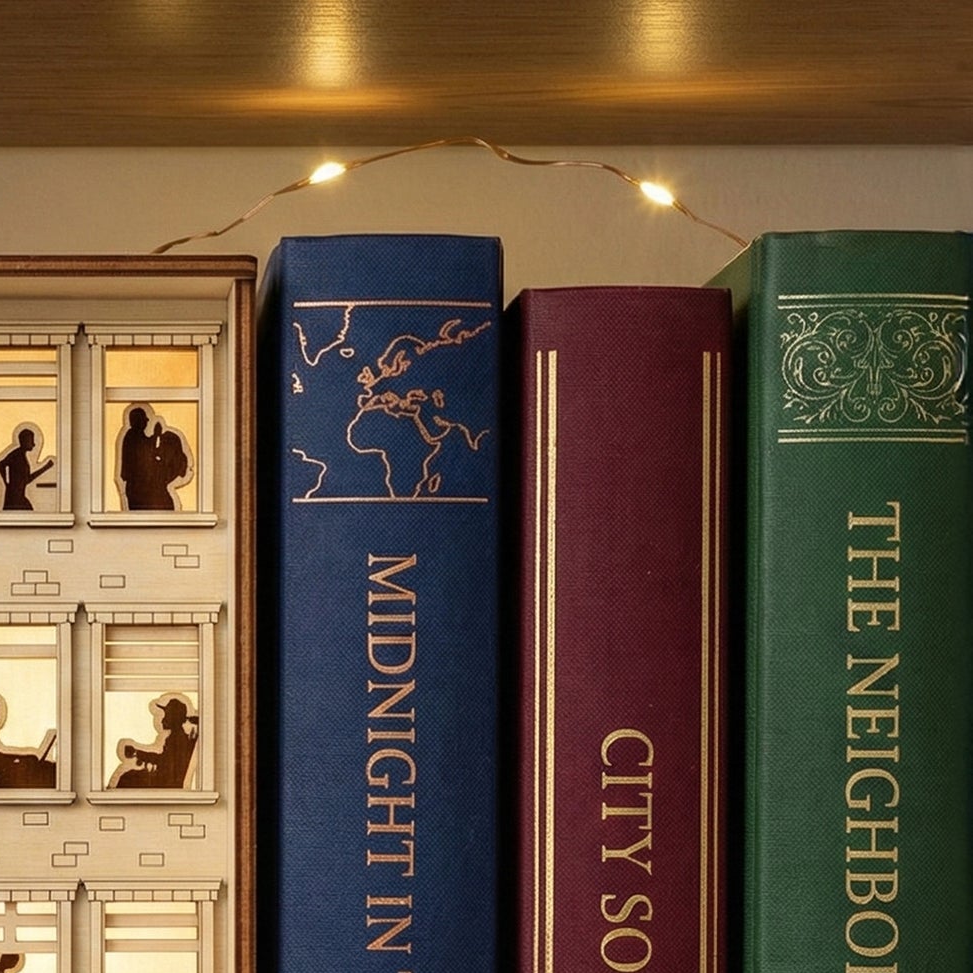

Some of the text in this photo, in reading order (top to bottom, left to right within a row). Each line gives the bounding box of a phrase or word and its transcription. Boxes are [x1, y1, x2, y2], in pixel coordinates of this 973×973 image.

[847, 501, 901, 633] THE
[366, 554, 417, 876] MIDNIGHT
[600, 728, 654, 874] CITY
[366, 894, 413, 953] IN
